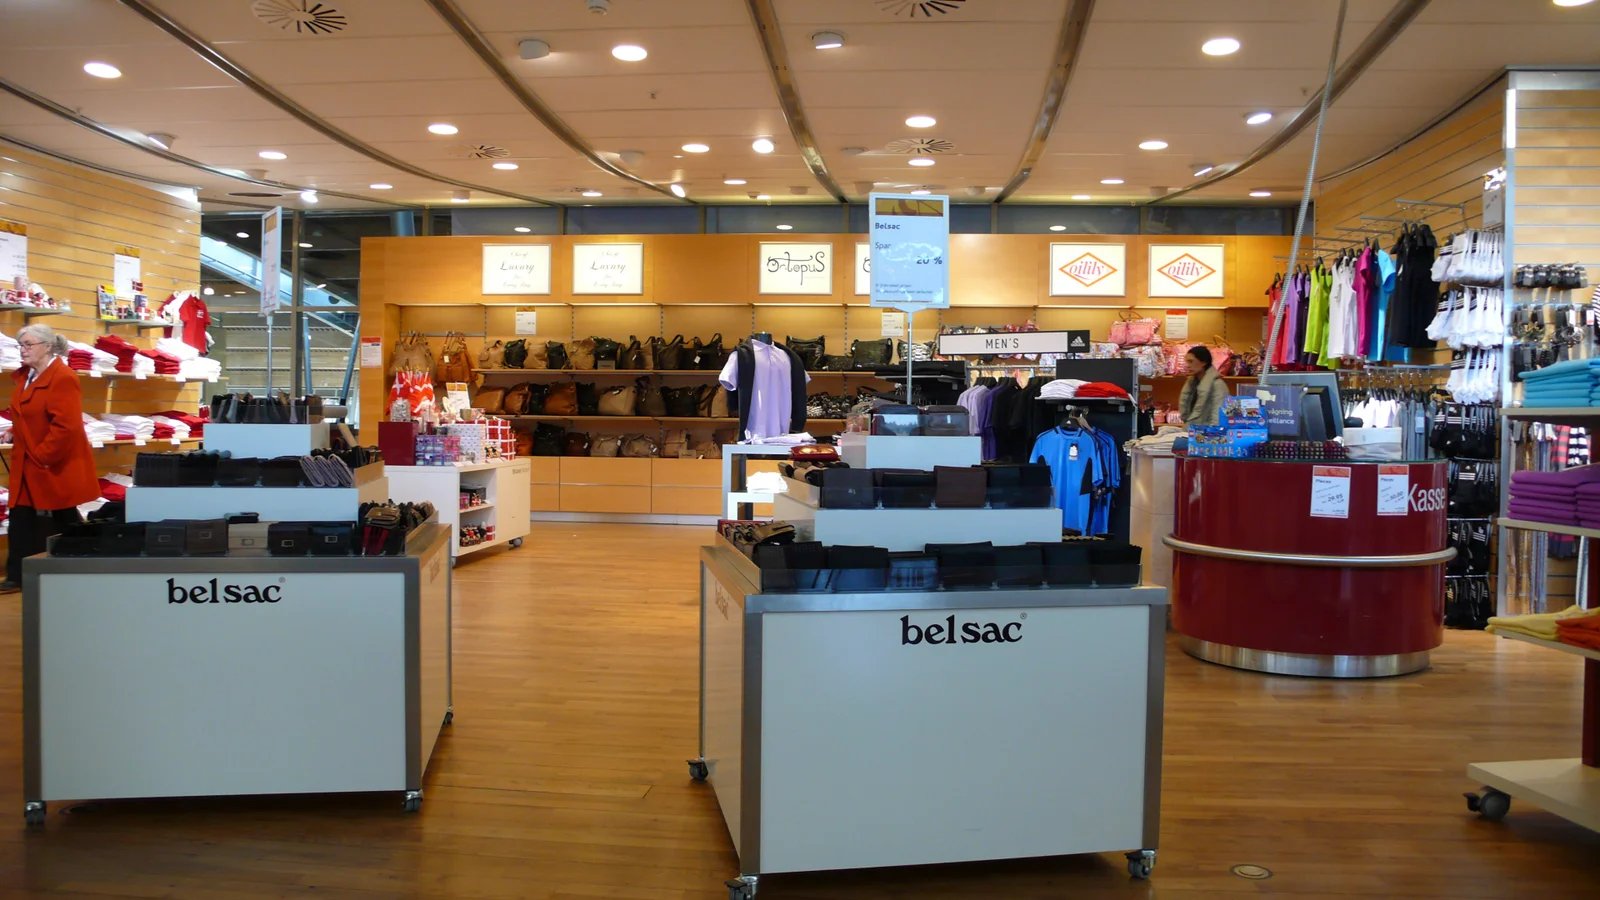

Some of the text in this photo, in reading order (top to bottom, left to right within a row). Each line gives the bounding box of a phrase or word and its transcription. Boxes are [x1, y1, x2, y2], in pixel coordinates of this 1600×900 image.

[875, 222, 901, 230] Belsac
[500, 260, 535, 274] Luxury
[590, 260, 627, 274] Luxury
[1069, 260, 1105, 277] oilily
[1167, 261, 1203, 278] oilily
[985, 338, 1019, 349] MEN'S
[1407, 483, 1446, 512] Kasse
